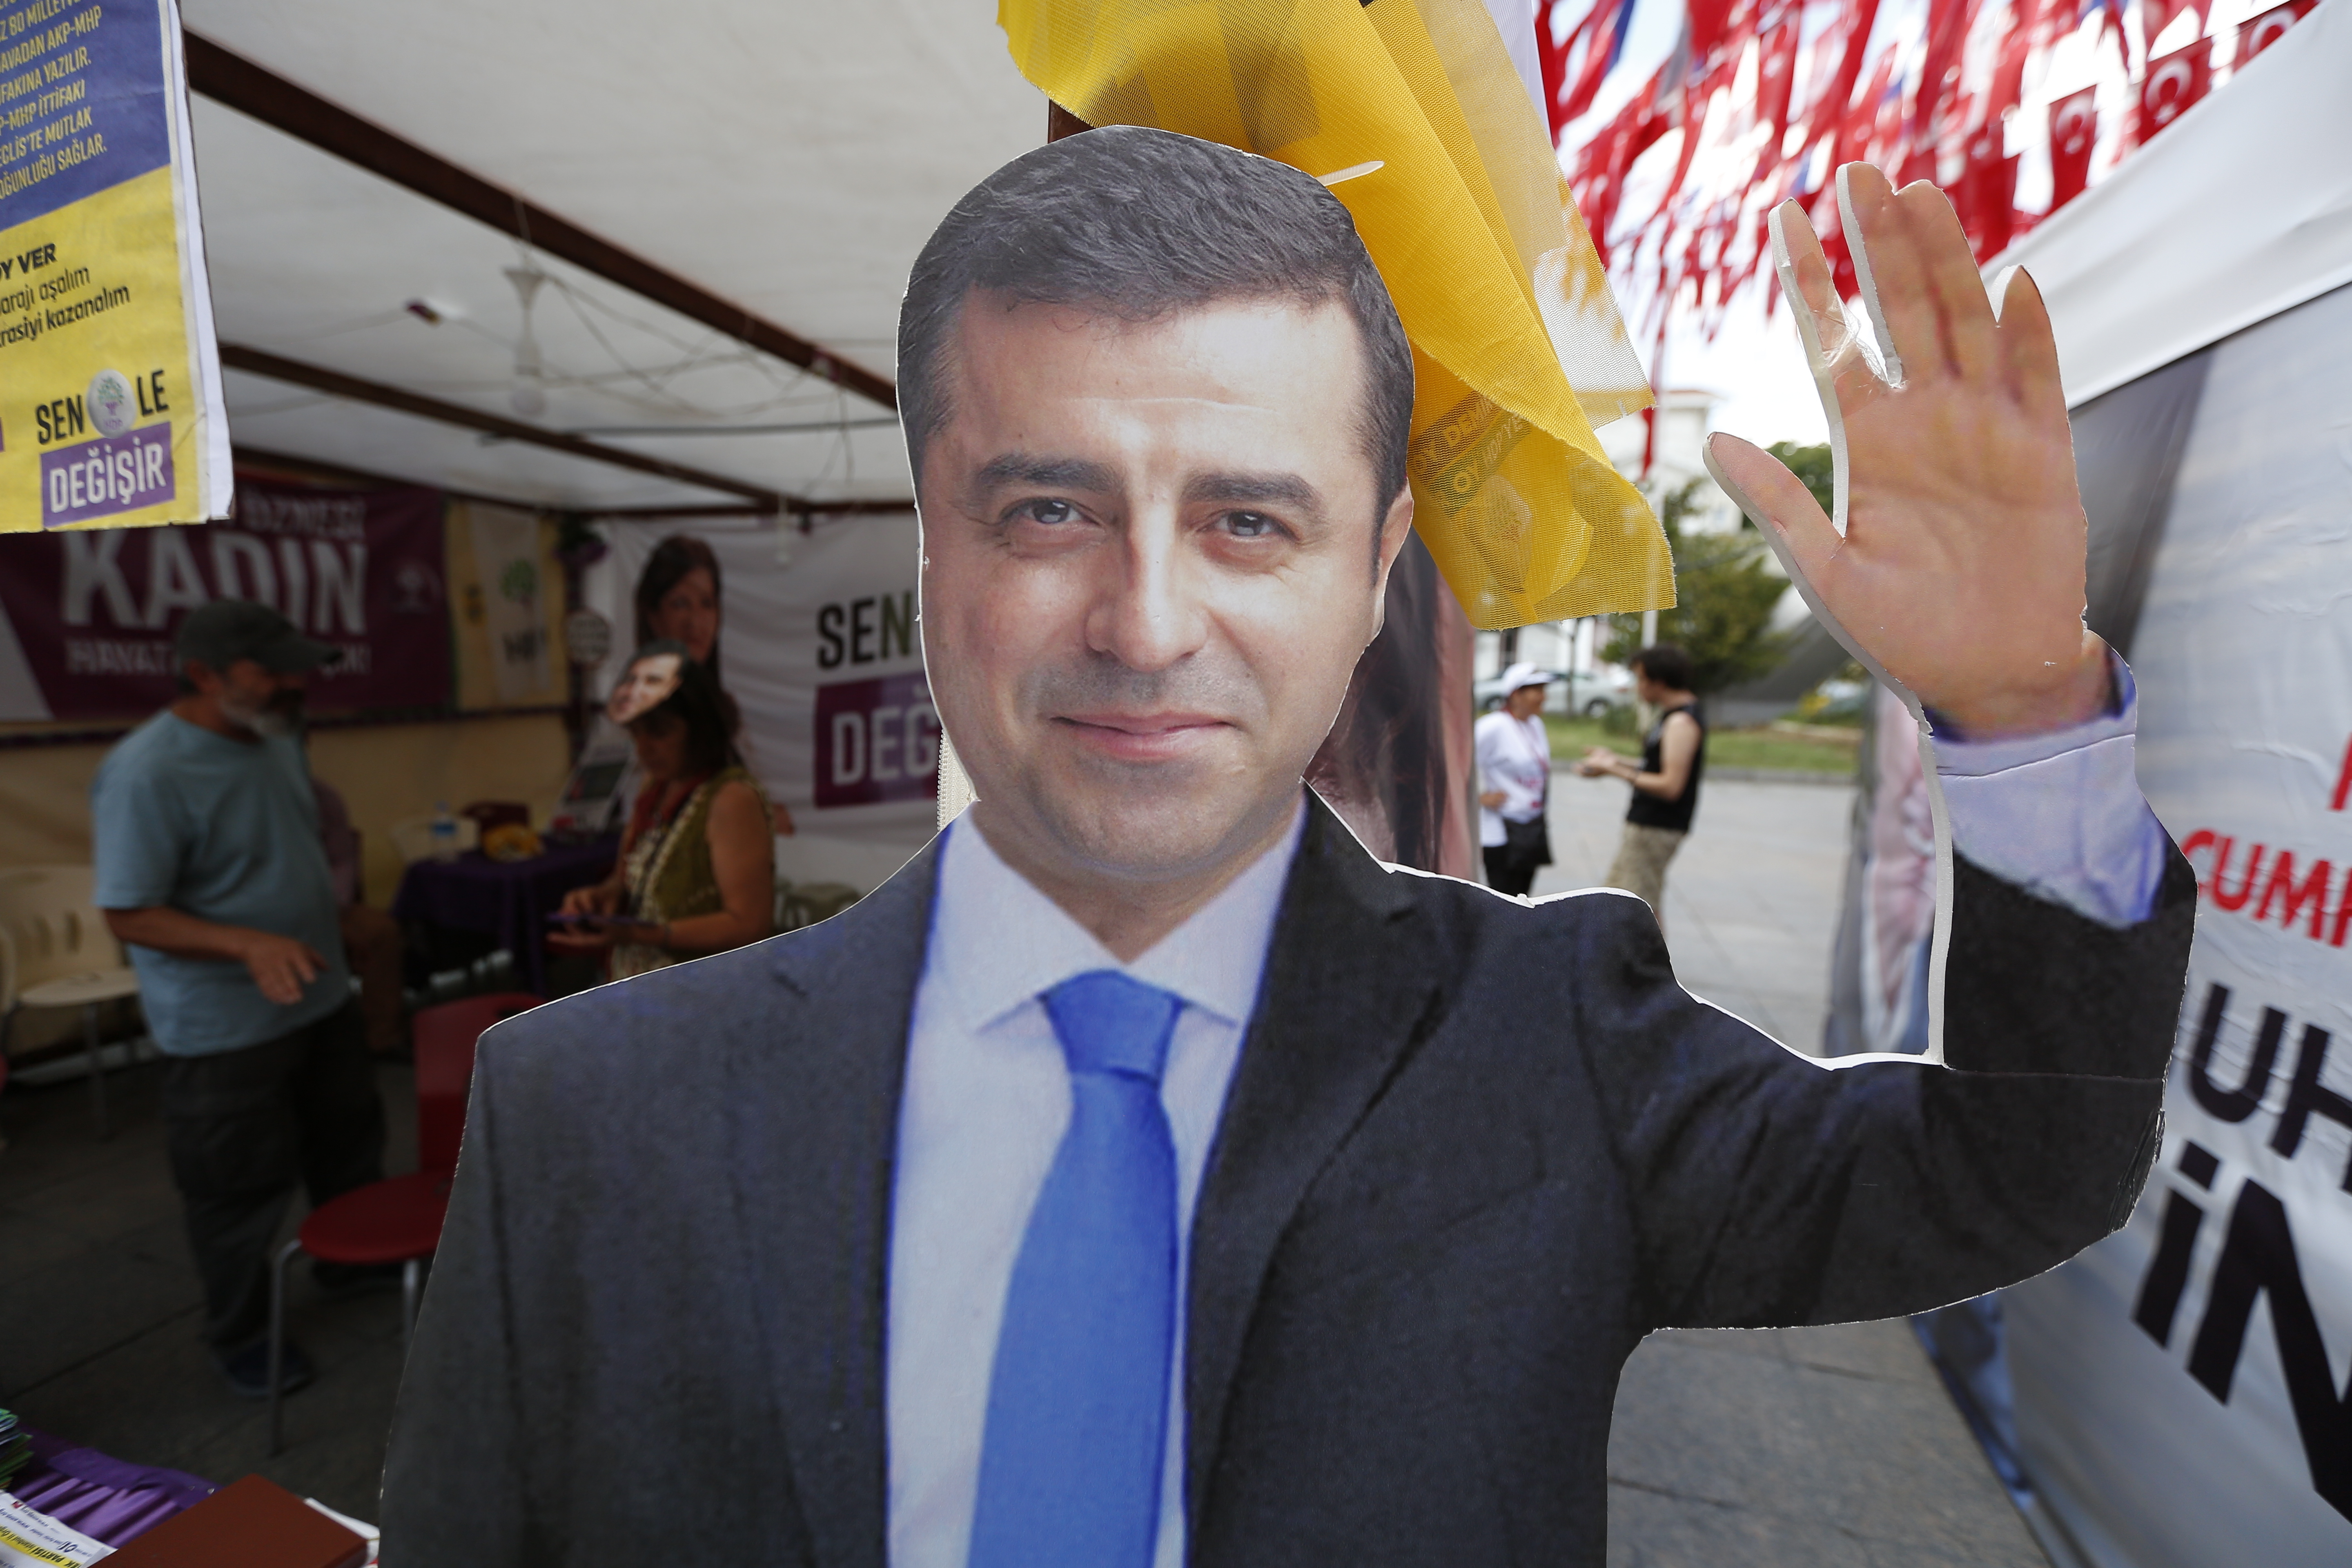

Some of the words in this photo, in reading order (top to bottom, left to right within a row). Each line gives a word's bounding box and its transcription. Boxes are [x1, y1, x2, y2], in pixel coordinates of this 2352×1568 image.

[8, 11, 25, 36] 80
[47, 5, 102, 51] AKP-MHP
[43, 46, 92, 83] YAZILIR.
[38, 78, 85, 118] İTTİFAKI
[0, 129, 43, 167] CLİS'TE
[45, 106, 93, 146] MUTLAK
[57, 133, 107, 171] SAĞLAR.
[0, 258, 13, 281] Y
[17, 243, 57, 274] VER
[39, 266, 91, 303] aşalım
[0, 311, 43, 347] rasiyi
[46, 285, 131, 331] kazanalım
[35, 394, 85, 445] SEN
[137, 369, 170, 418] LE
[49, 436, 167, 513] DEĞİŞİR
[61, 527, 368, 635] KADIN
[818, 589, 912, 671] SEN
